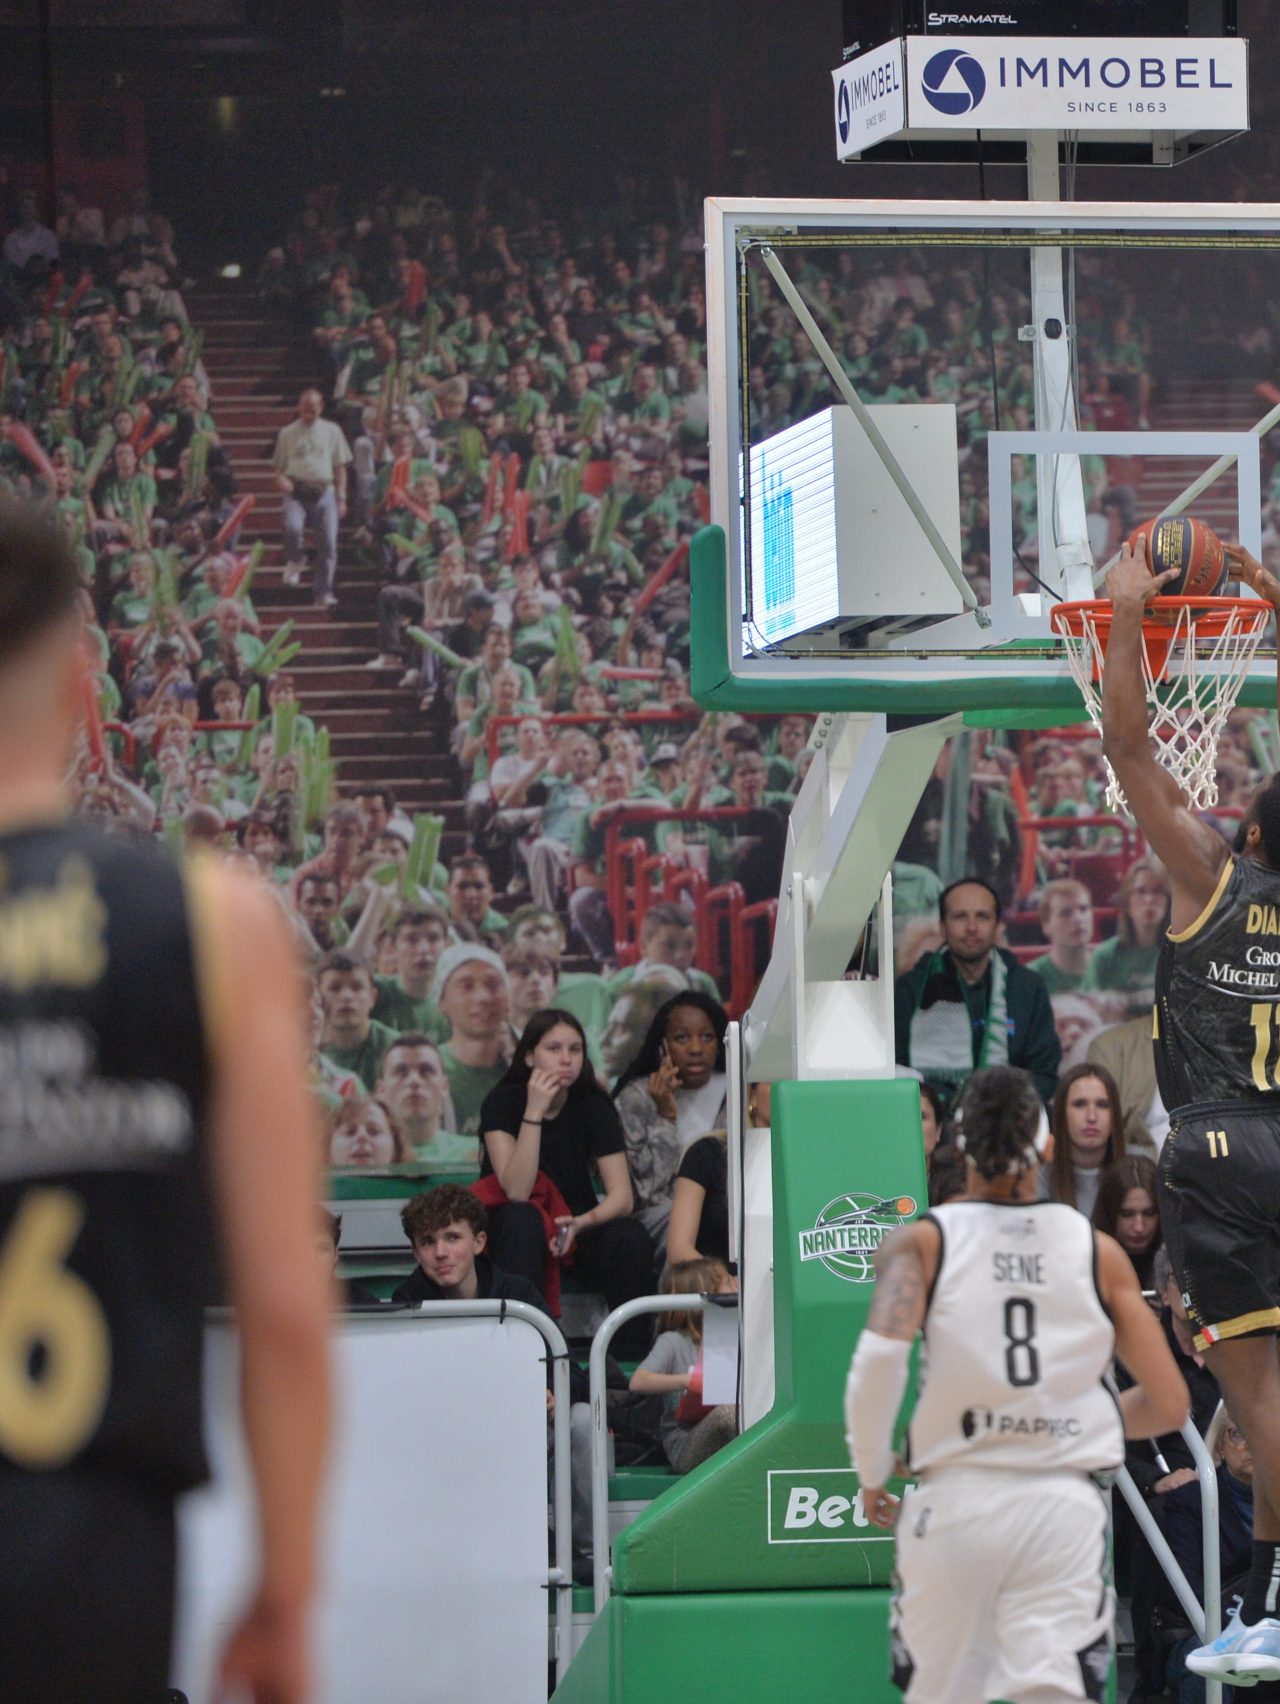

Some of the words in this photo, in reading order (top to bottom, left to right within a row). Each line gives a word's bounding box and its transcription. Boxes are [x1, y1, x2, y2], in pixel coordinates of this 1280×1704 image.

[927, 12, 1018, 25] STRAMATEL
[850, 60, 900, 112] IMMOBEL
[999, 57, 1233, 89] IMMOBEL
[1066, 102, 1119, 113] SINCE
[1127, 102, 1168, 113] 1863
[1205, 961, 1279, 987] MICHEL
[1205, 1130, 1230, 1159] 11
[802, 1226, 890, 1256] NANTERR
[993, 1252, 1048, 1285] SENE
[1004, 1296, 1041, 1388] 8
